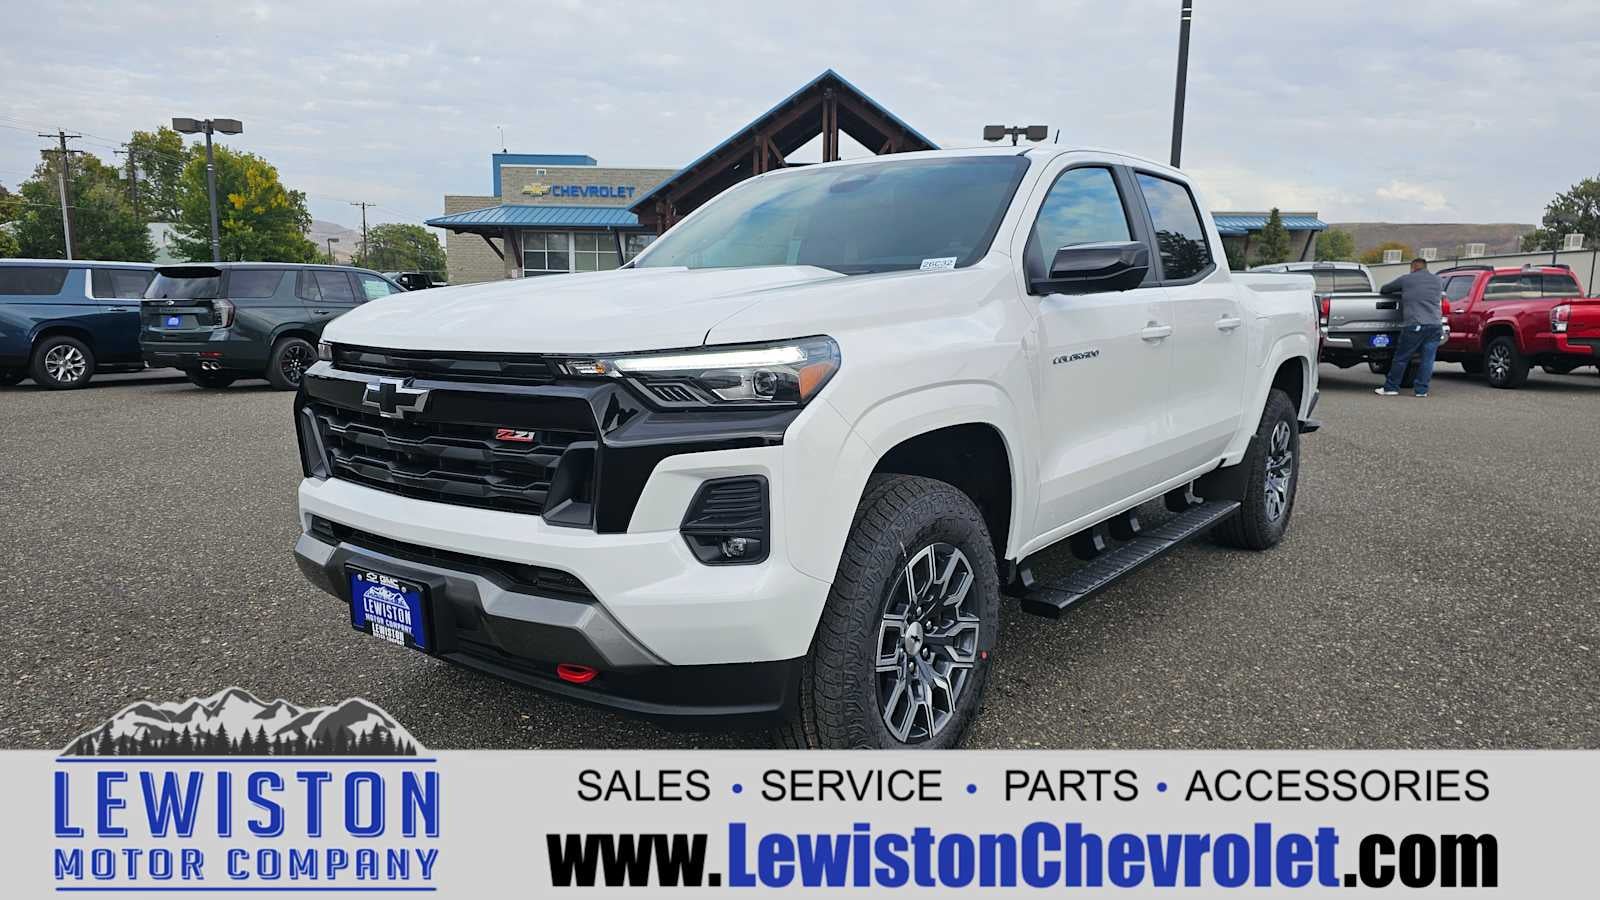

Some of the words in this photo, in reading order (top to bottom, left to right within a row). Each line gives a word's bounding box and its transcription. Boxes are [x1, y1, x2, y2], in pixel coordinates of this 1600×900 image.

[552, 184, 635, 198] CHEVROLET
[1052, 350, 1100, 365] COLORADO
[495, 427, 536, 442] Z71
[363, 597, 412, 626] LEWISTON
[365, 613, 385, 625] MOTOR
[385, 619, 413, 636] COMPANY
[371, 622, 405, 642] LEWISTON
